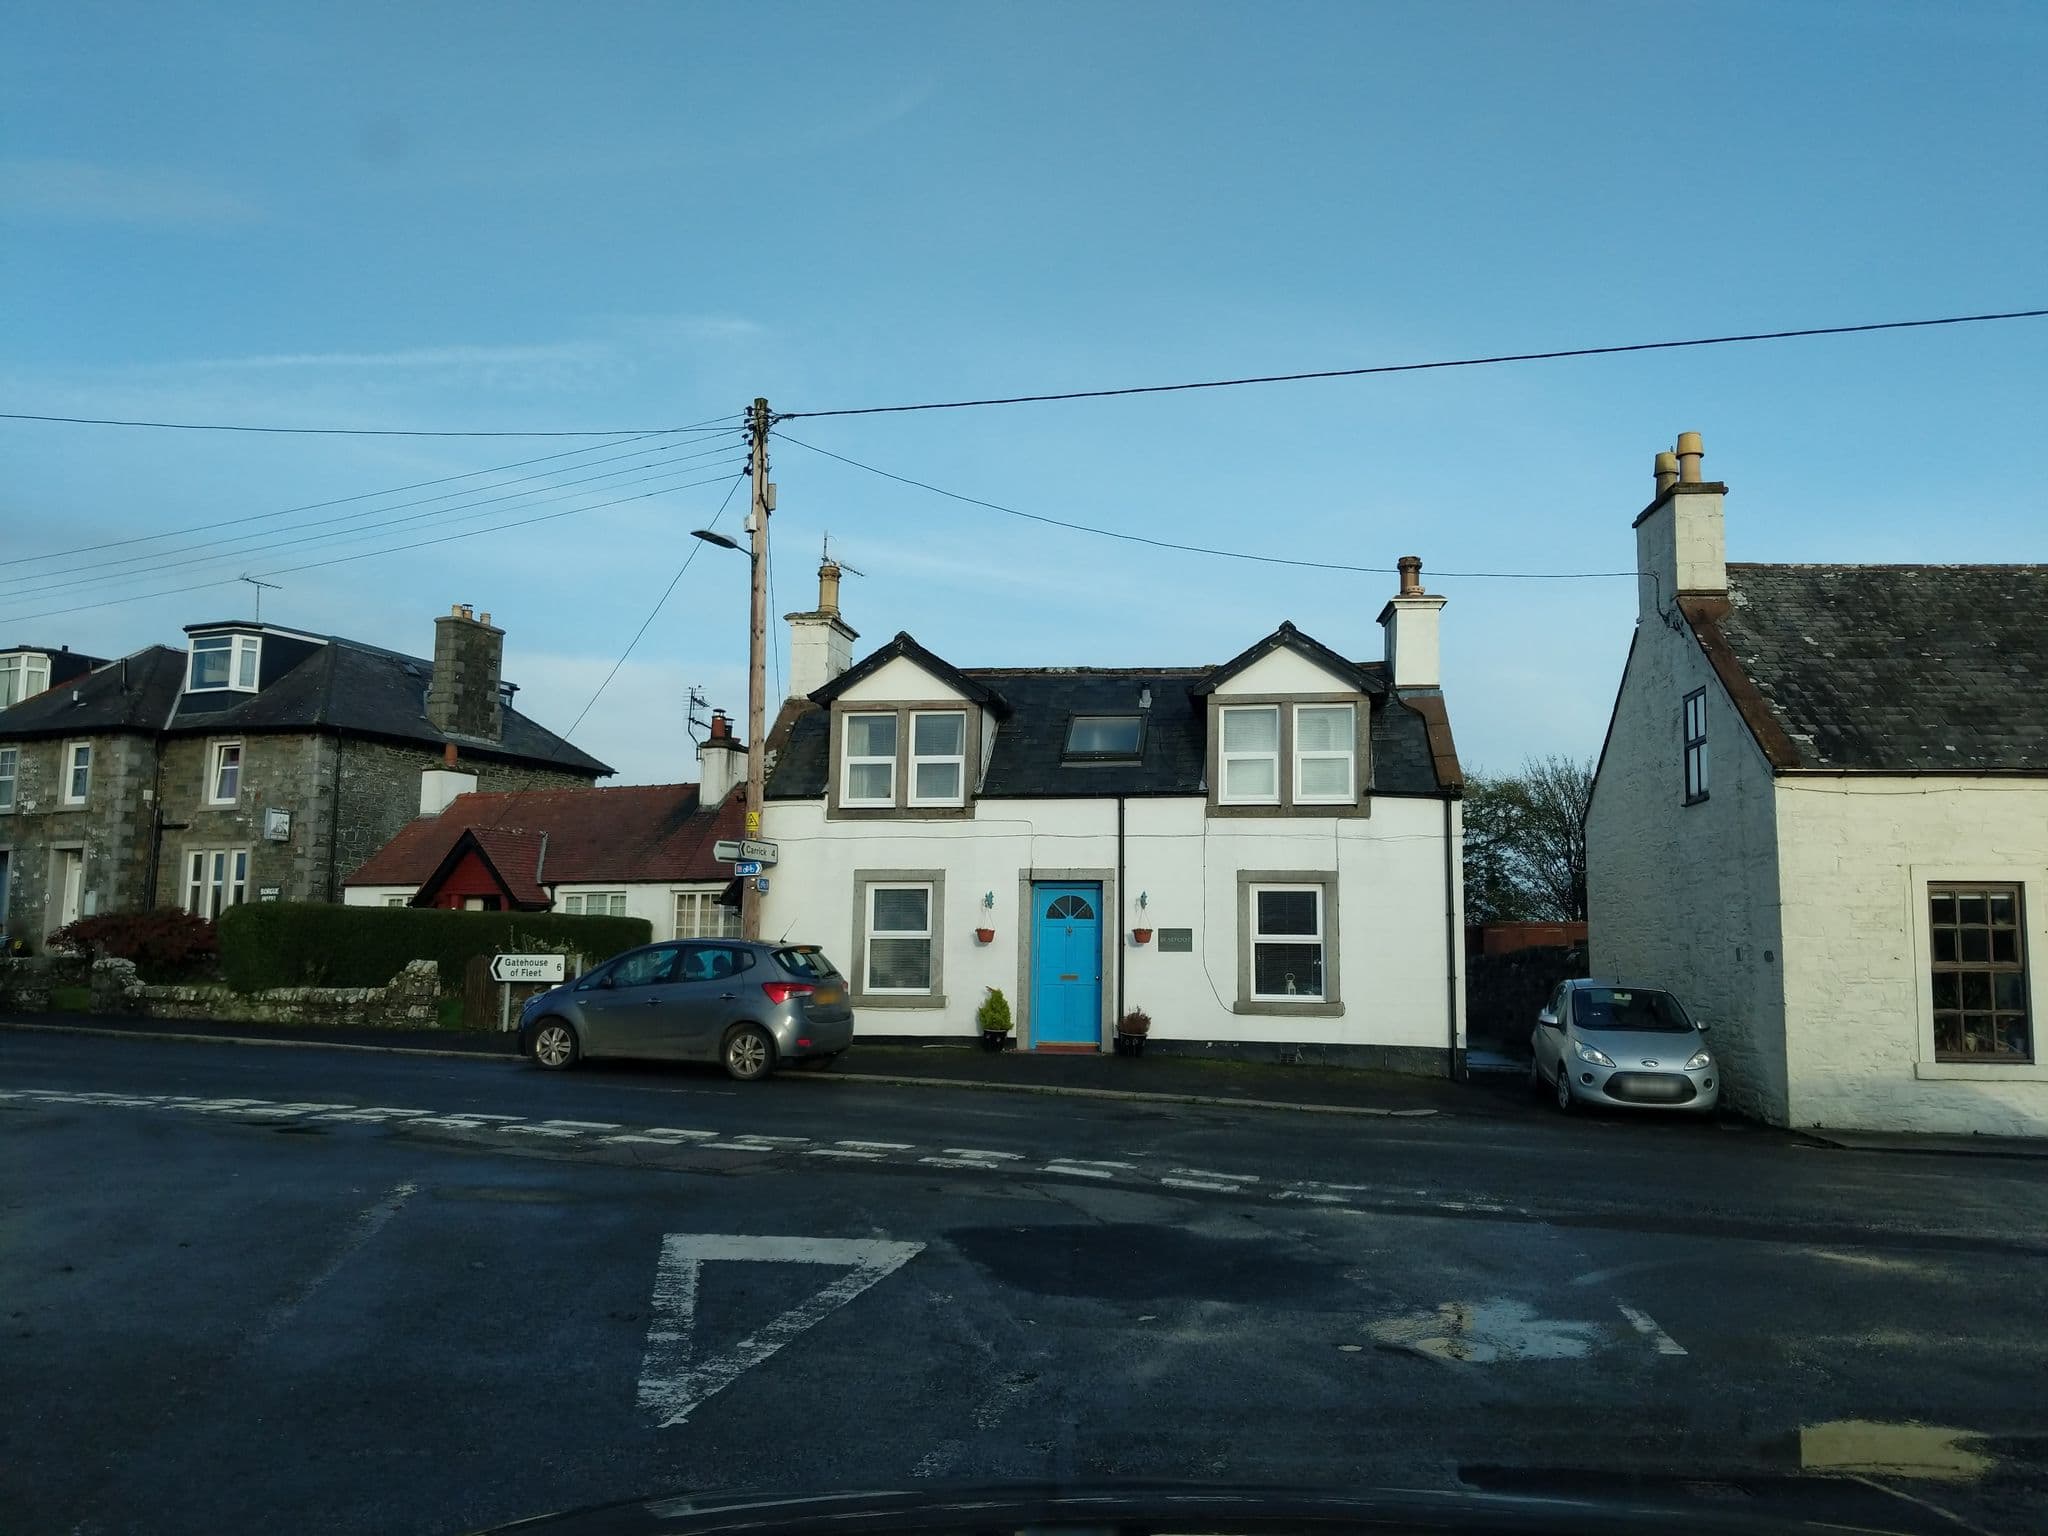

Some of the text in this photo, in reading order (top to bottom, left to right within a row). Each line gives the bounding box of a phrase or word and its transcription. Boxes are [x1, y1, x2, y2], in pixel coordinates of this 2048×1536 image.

[746, 845, 767, 857] Carrick
[504, 958, 549, 967] Gatehouse
[556, 963, 562, 971] 6
[510, 968, 542, 977] of Fleet
